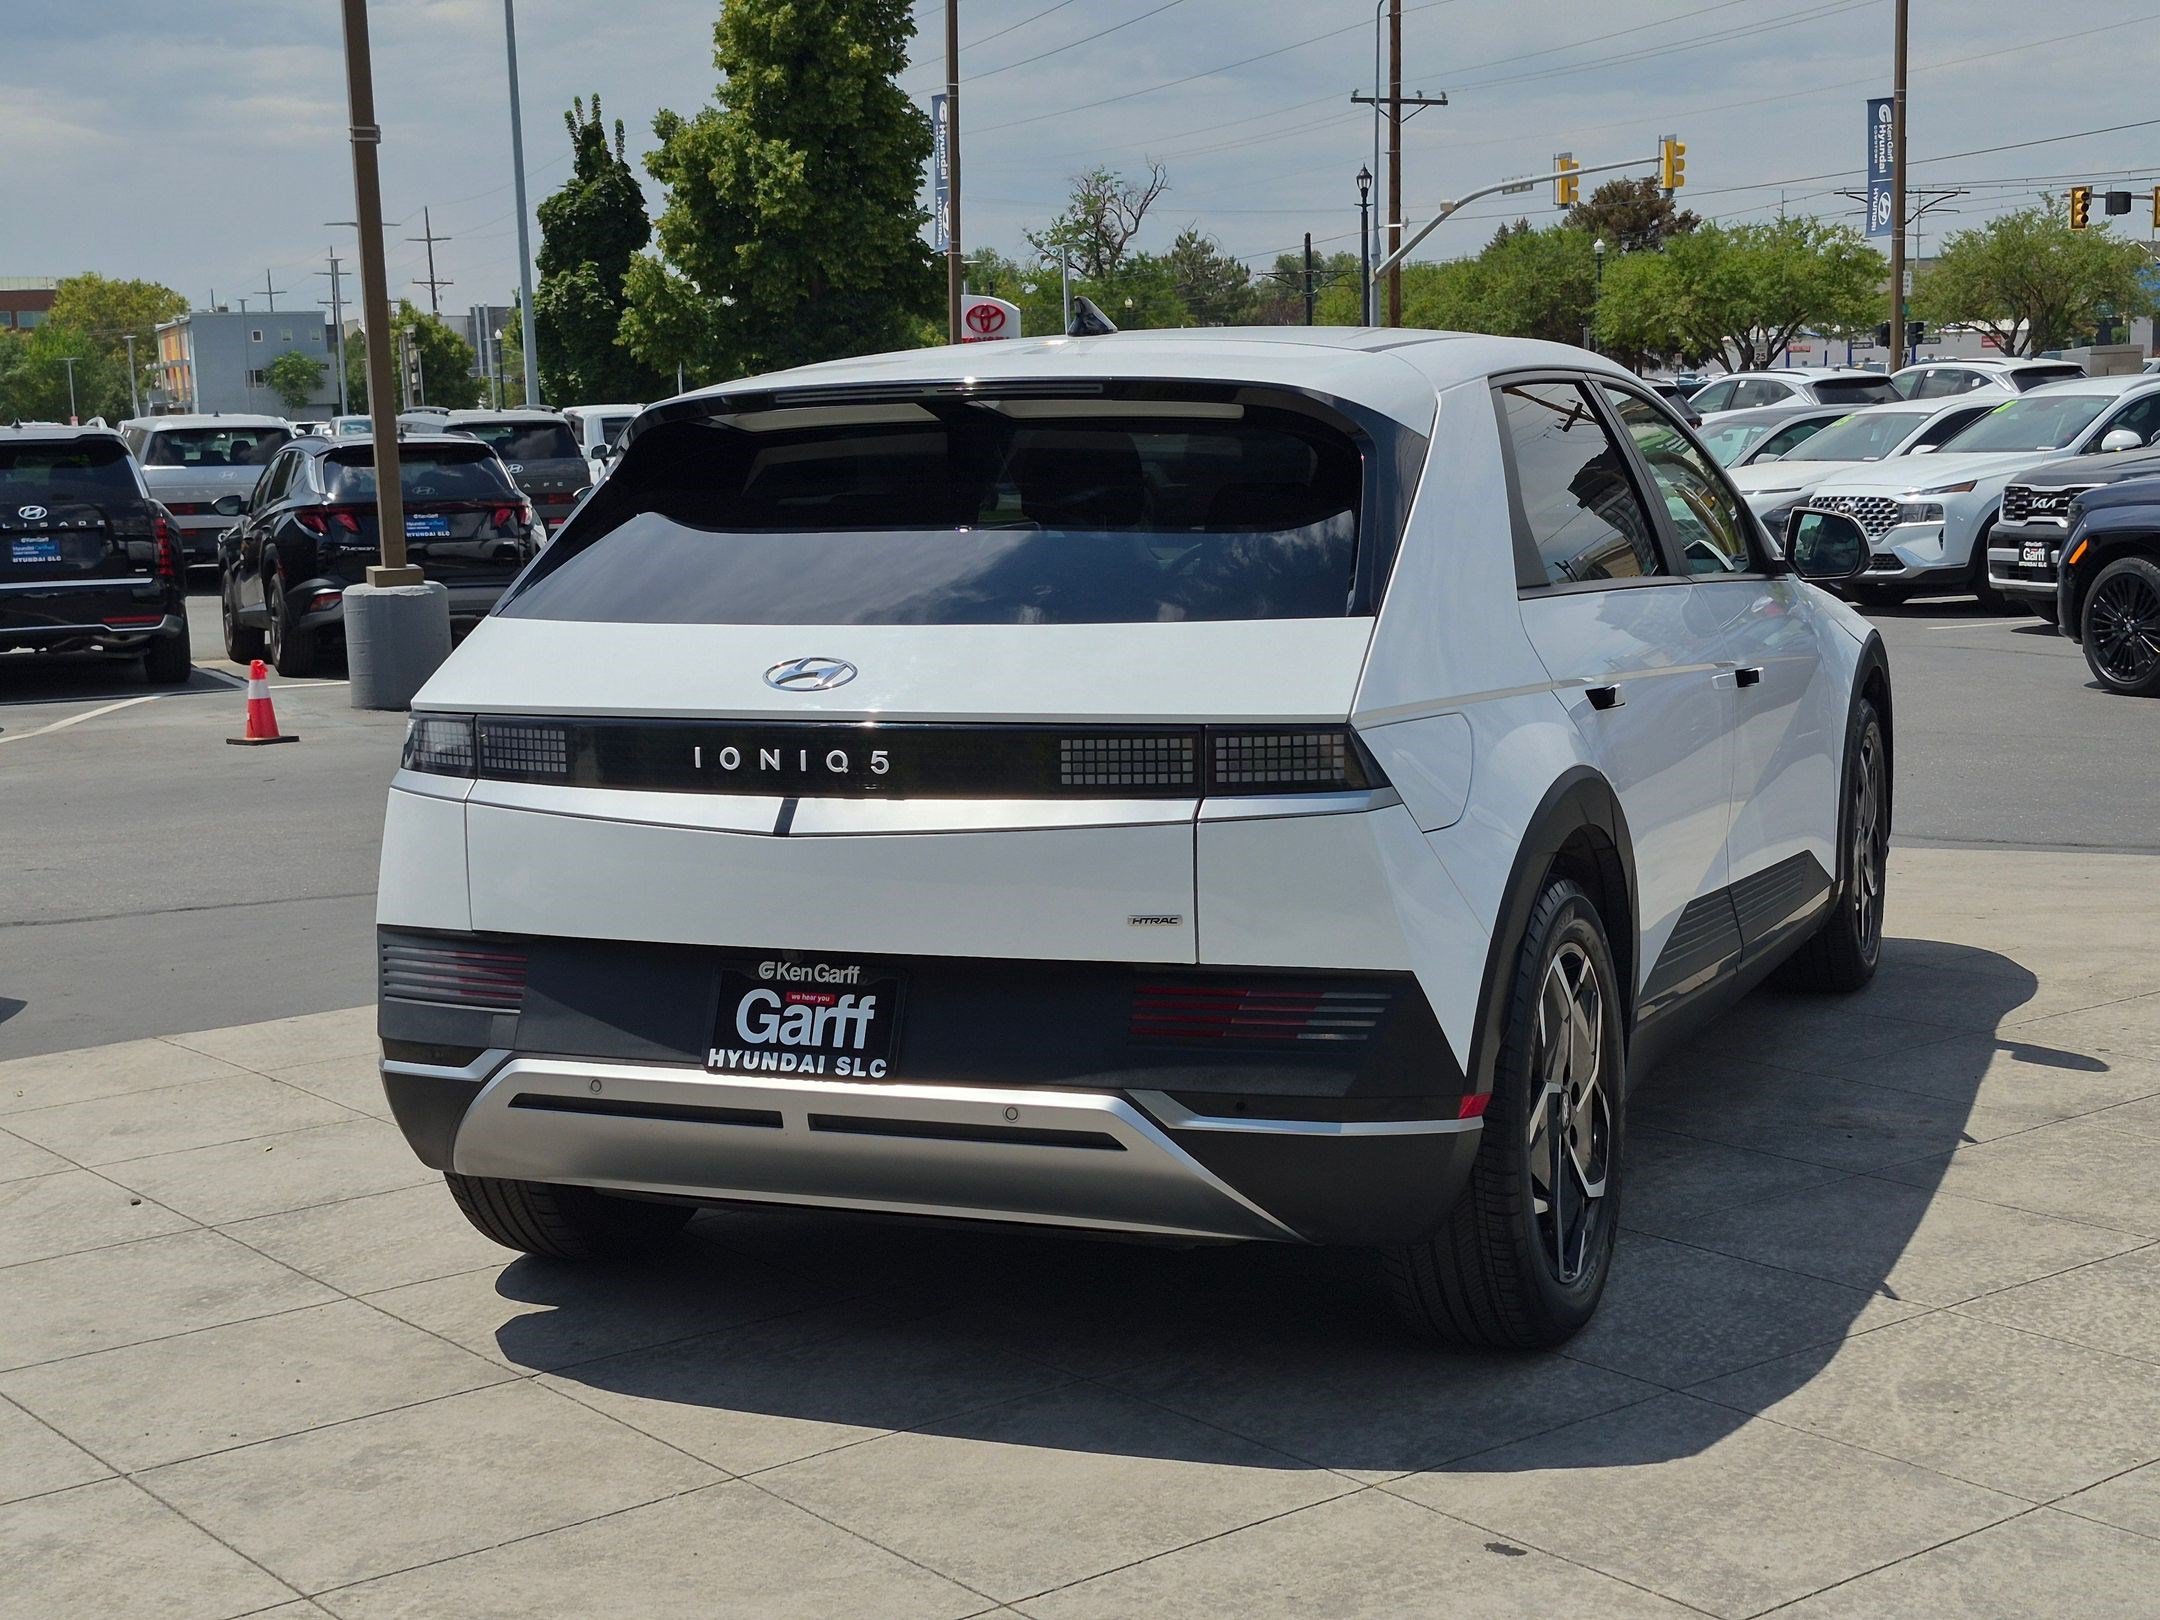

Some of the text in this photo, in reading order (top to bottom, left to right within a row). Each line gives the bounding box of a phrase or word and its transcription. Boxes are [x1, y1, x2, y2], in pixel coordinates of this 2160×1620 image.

[939, 124, 949, 180] Hyundai
[1879, 124, 1887, 174] Hyundai
[1755, 352, 1766, 361] 25
[2022, 547, 2045, 561] Garff
[694, 746, 890, 775] IONIQ 5
[1132, 917, 1179, 925] HTRAC
[801, 993, 816, 1001] hear
[817, 995, 830, 1003] you
[736, 988, 877, 1050] Garff
[707, 1048, 888, 1079] HYUNDAI SLC
